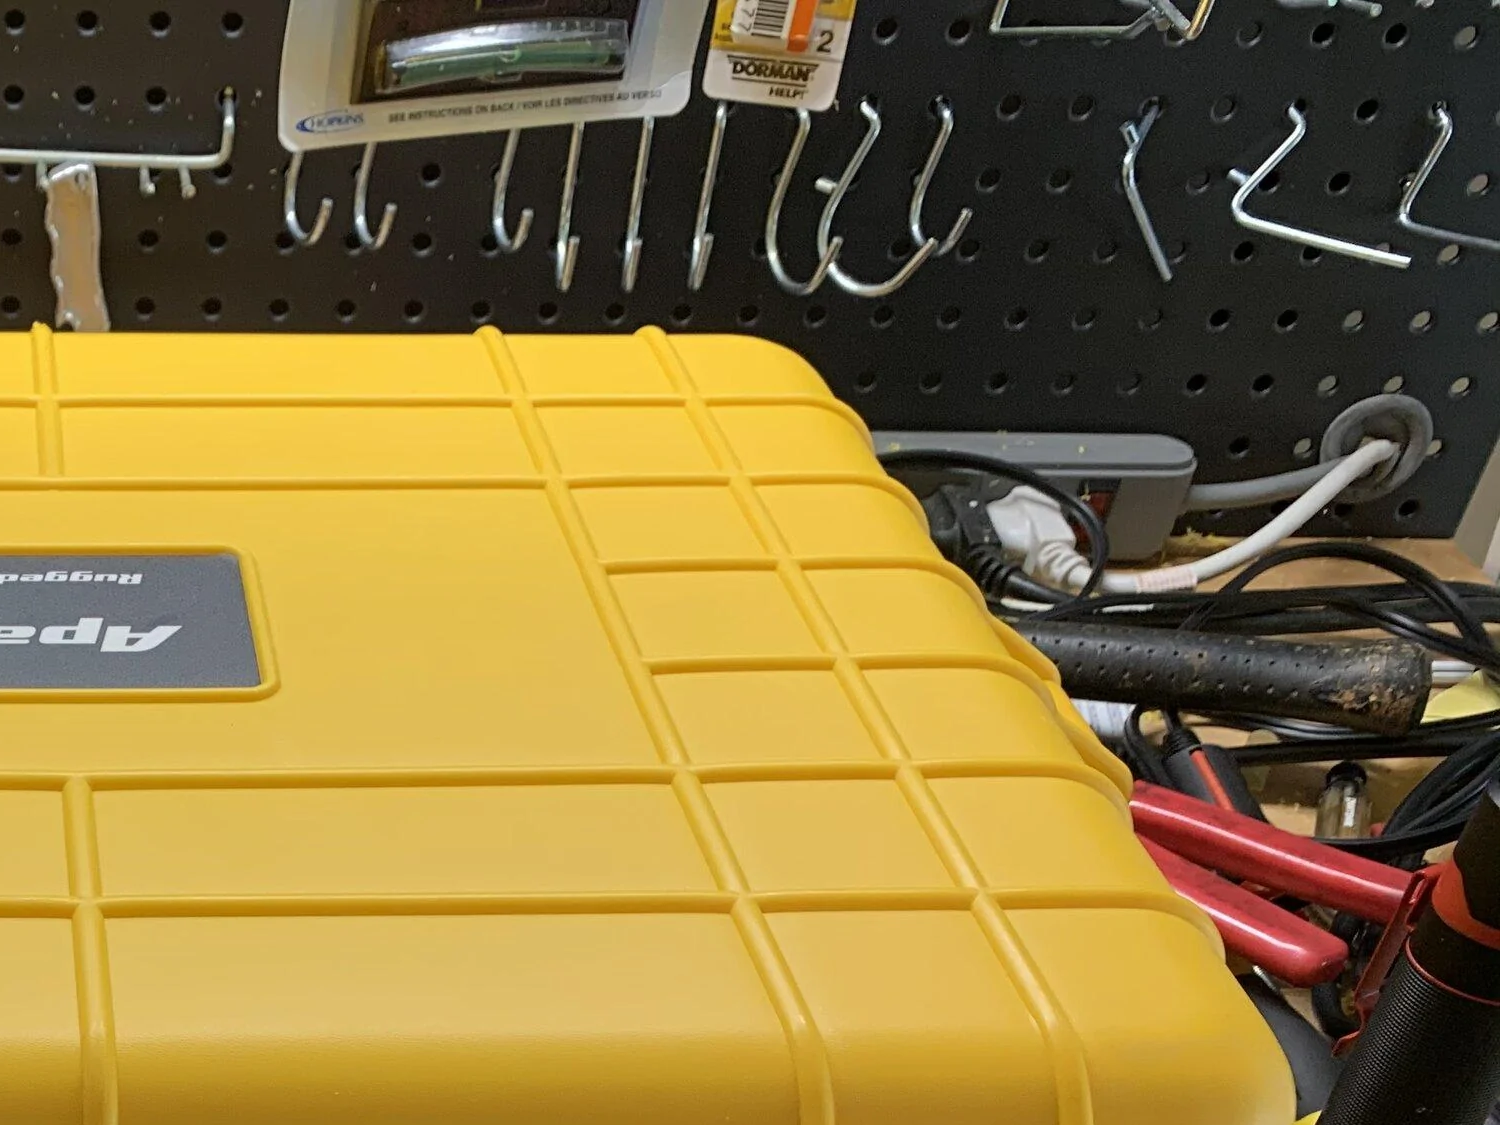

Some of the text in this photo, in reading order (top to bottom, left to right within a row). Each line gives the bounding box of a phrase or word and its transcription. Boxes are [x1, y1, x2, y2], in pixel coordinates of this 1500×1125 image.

[815, 30, 834, 53] 2
[732, 61, 812, 82] DORMAN
[388, 110, 406, 123] SEE
[408, 106, 473, 121] INSTRUCTIONS
[474, 105, 488, 115] ON
[490, 102, 514, 113] BACK
[522, 101, 543, 110] VOIR
[544, 97, 561, 108] LES
[564, 92, 615, 107] DIRECTIVES
[616, 91, 630, 101] AU
[632, 89, 663, 100] VERSO
[311, 113, 365, 128] HOPKINS
